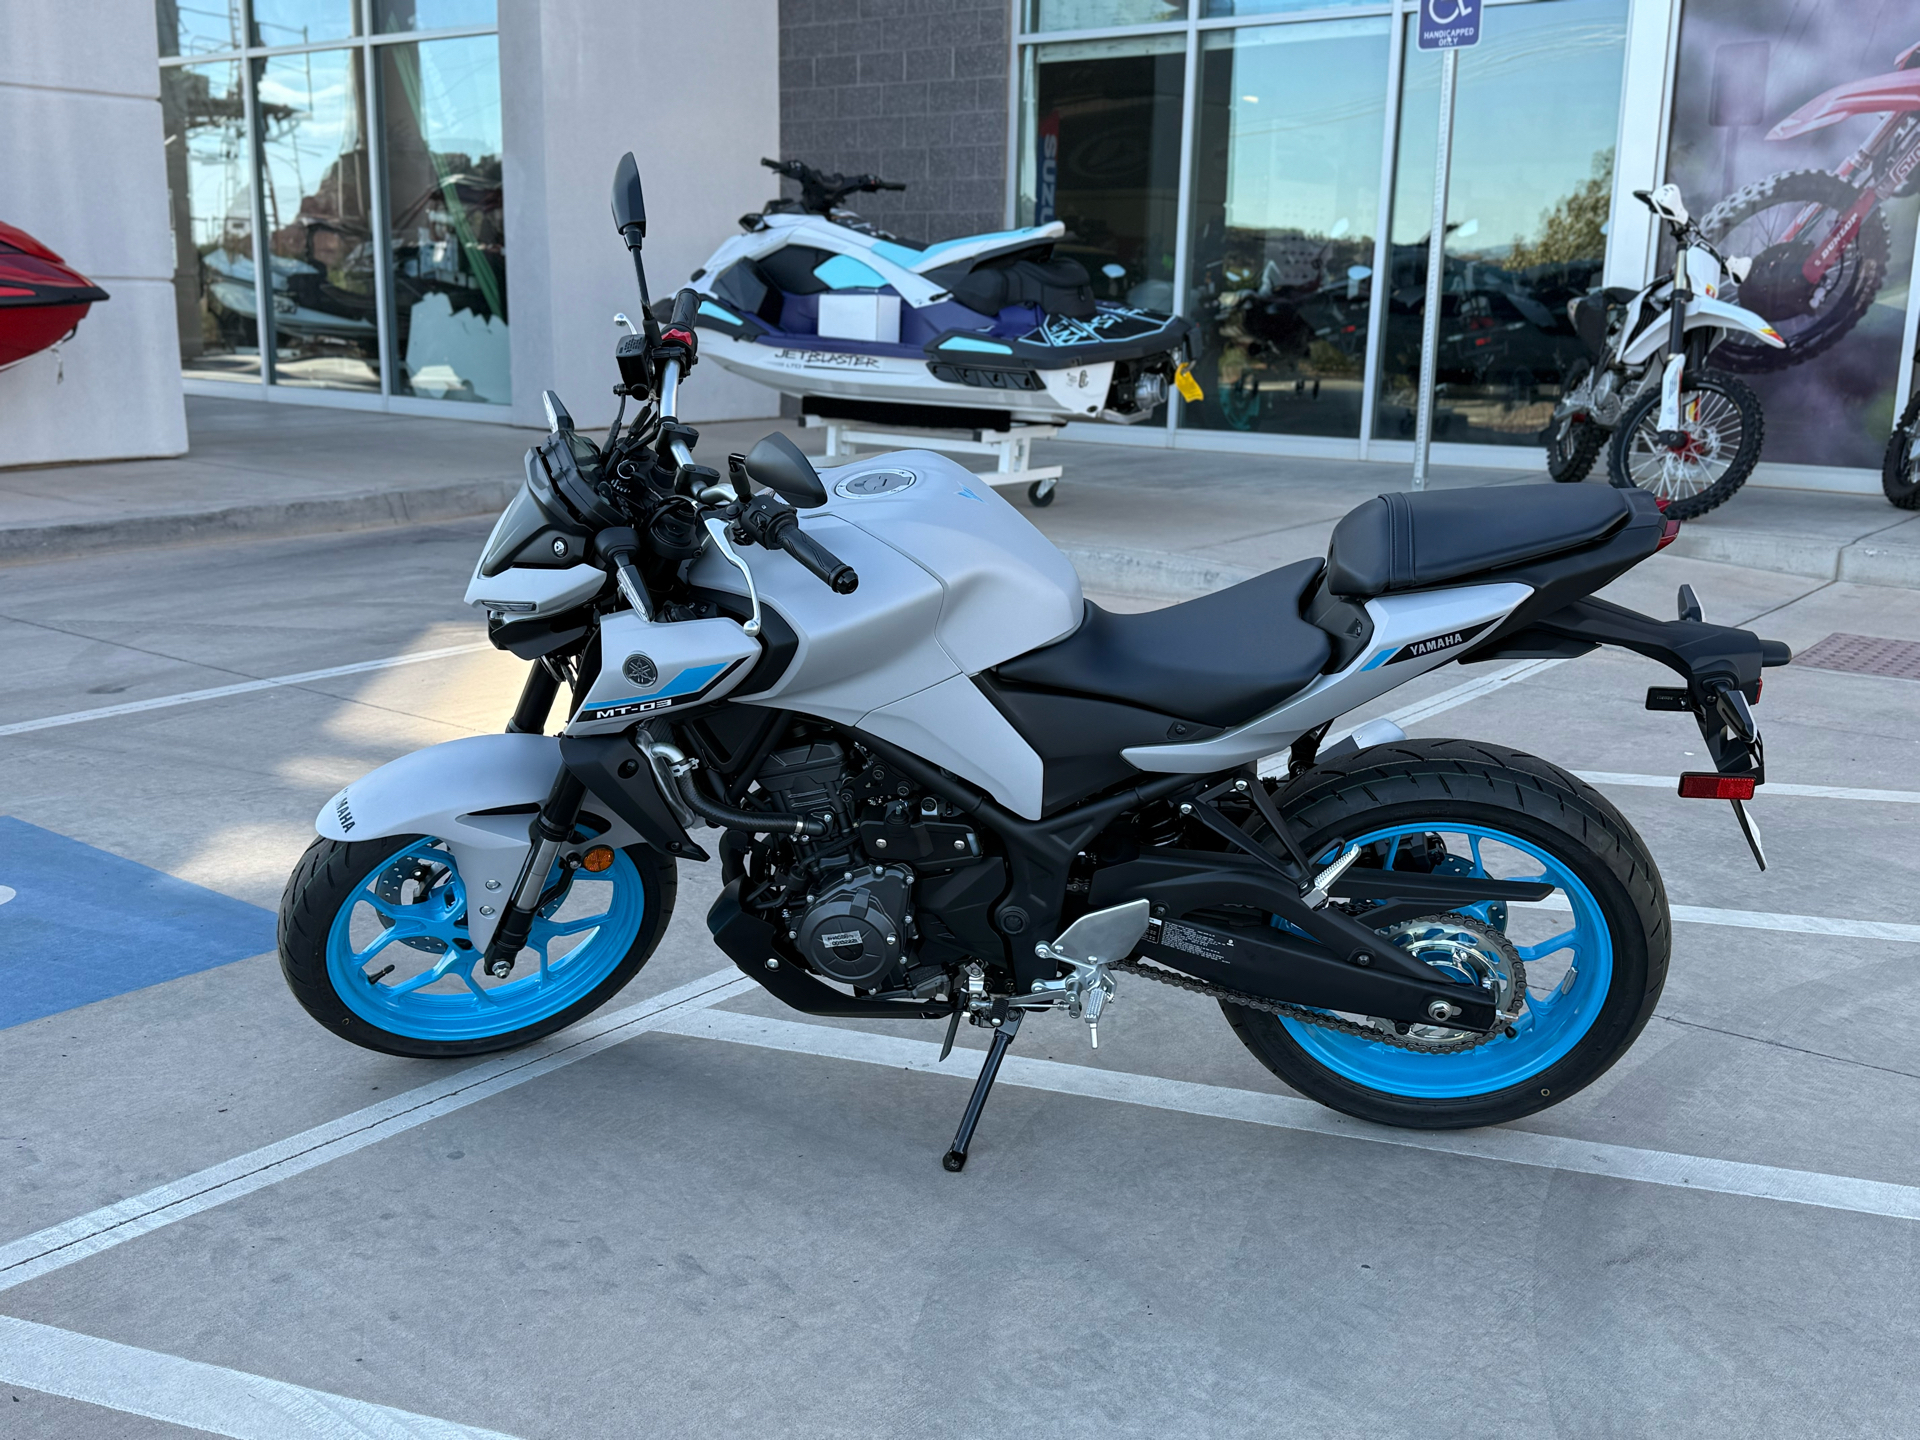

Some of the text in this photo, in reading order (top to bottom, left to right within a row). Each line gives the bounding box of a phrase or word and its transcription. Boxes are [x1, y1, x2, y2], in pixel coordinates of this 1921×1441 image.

[1423, 27, 1475, 40] HANDICAPPED
[1820, 212, 1859, 261] DUNLOP
[1409, 632, 1463, 656] YAMAHA
[596, 698, 672, 719] MT-03
